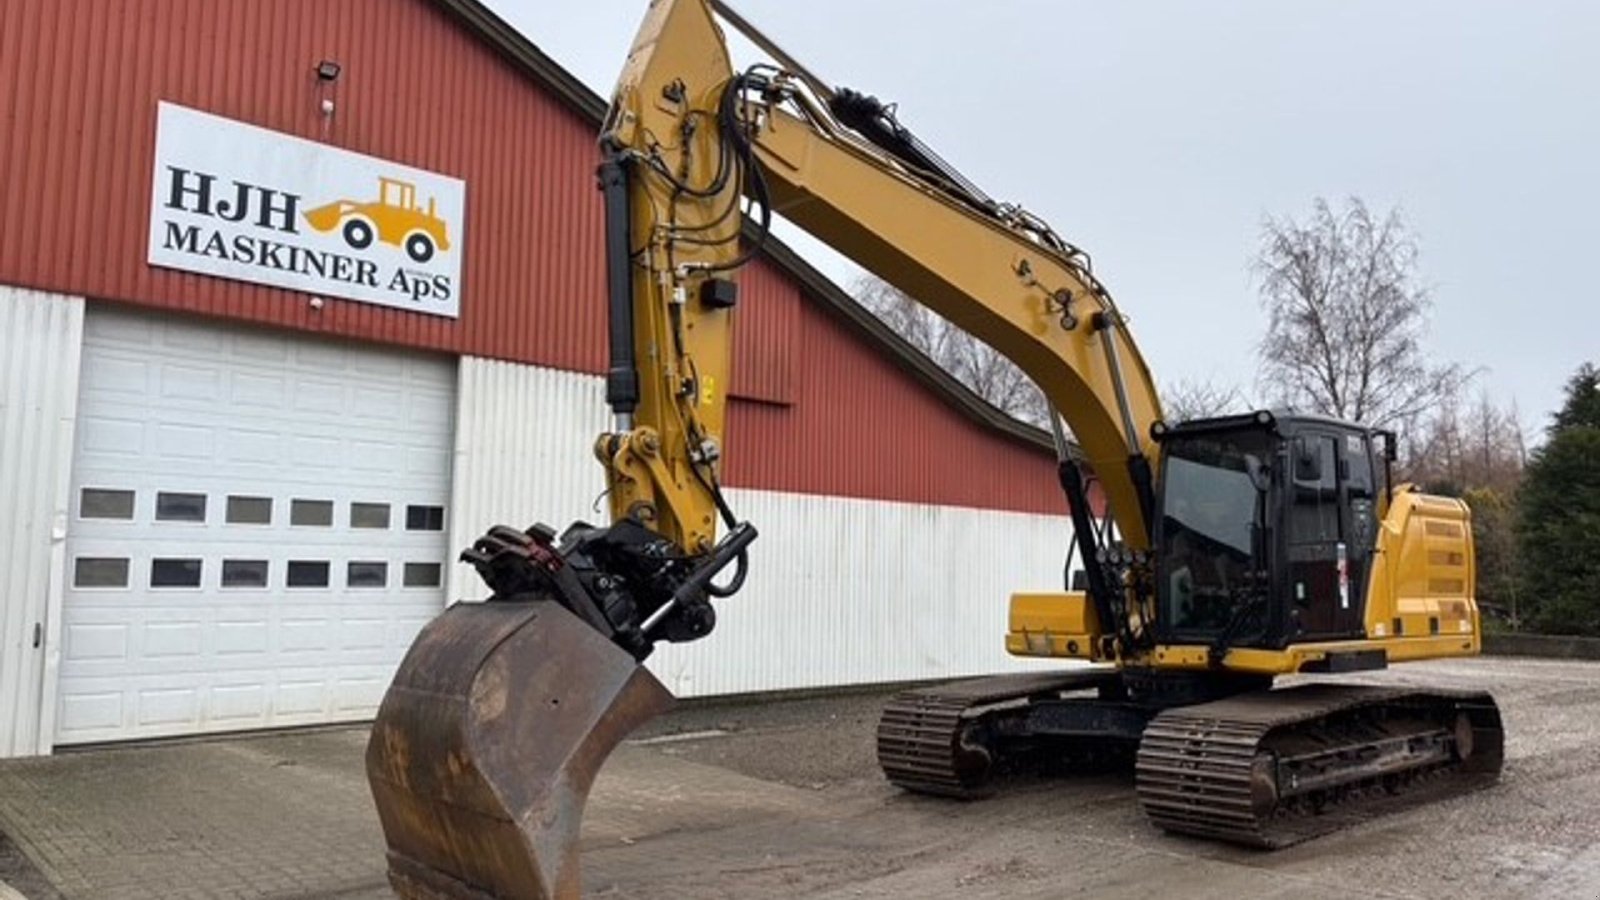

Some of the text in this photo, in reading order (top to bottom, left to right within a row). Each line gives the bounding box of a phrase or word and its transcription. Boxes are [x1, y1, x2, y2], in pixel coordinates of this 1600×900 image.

[165, 165, 300, 234] HJH
[163, 221, 451, 301] MASKINER ApS
